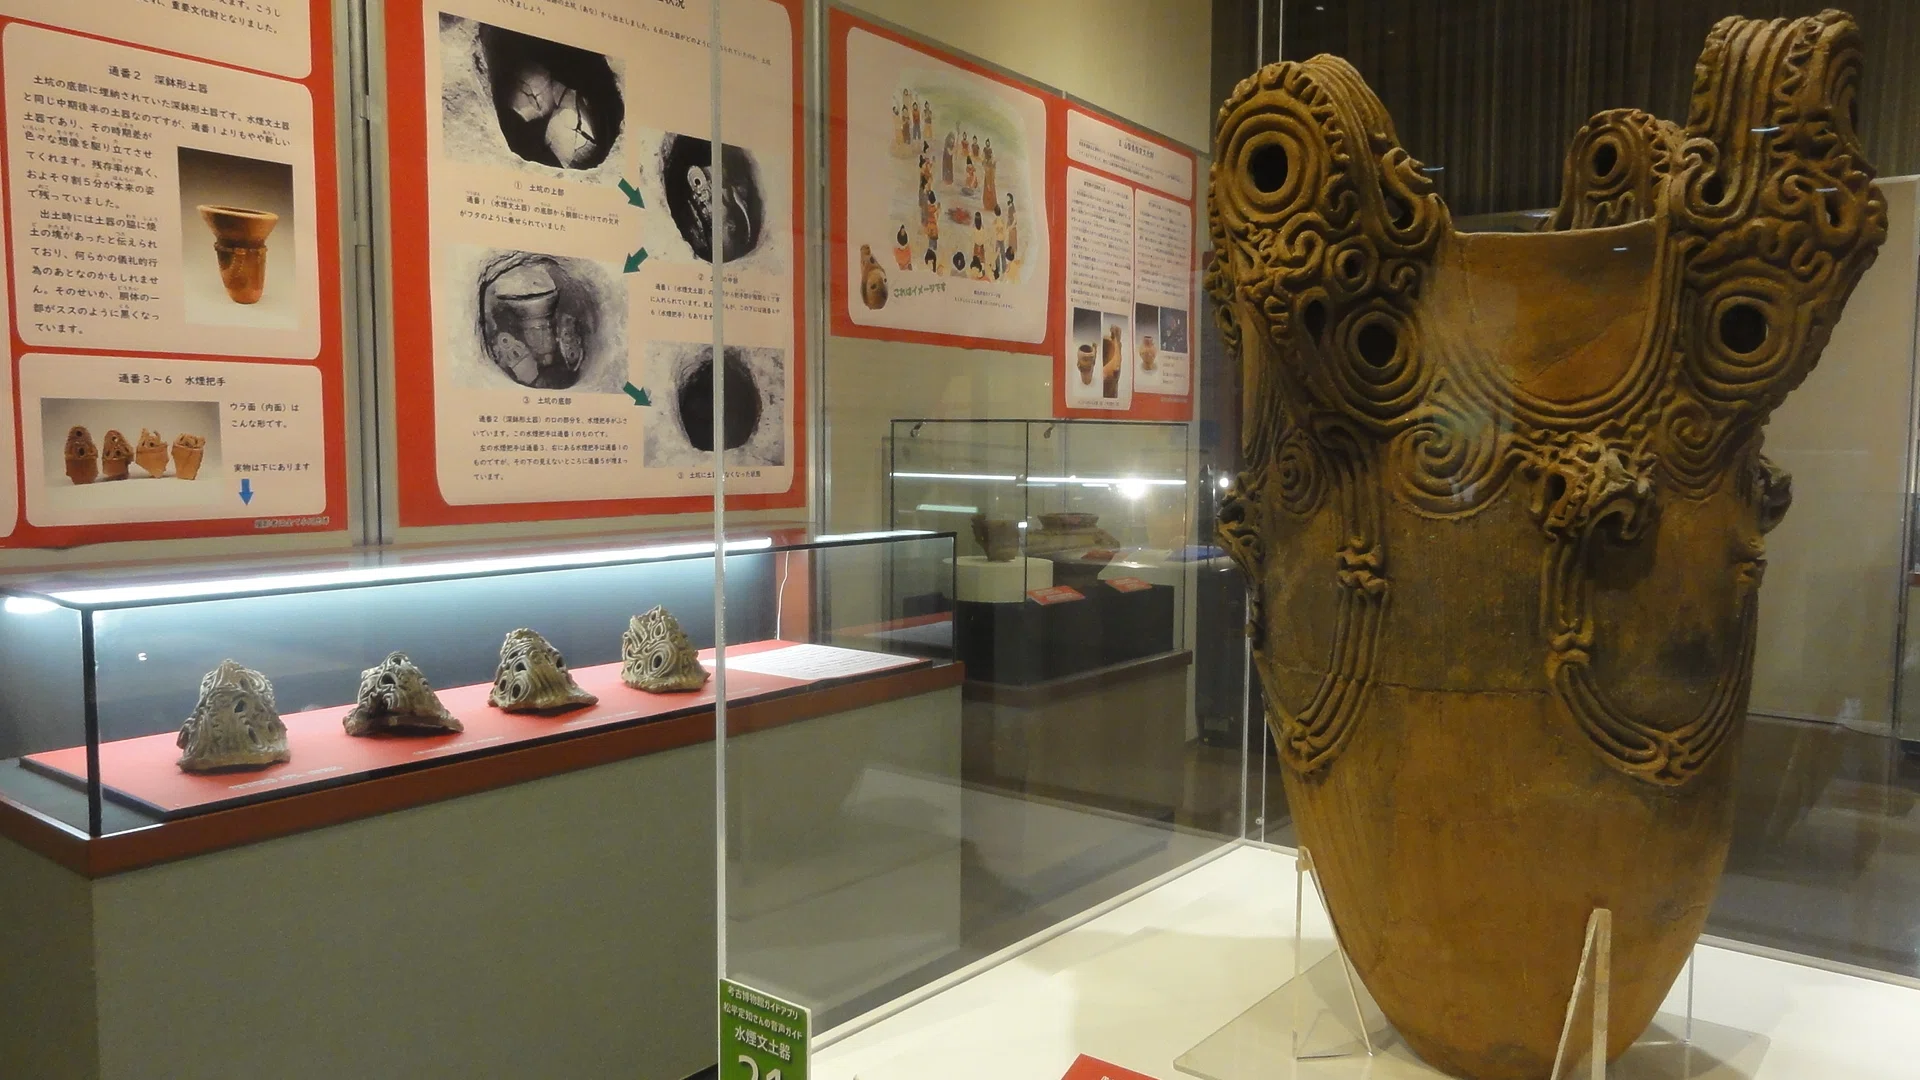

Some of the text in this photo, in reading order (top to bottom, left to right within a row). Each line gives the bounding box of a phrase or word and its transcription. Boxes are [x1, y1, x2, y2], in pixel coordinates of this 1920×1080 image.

[108, 65, 208, 94] 通番2 深鉢形土器
[35, 323, 84, 335] ています。
[185, 375, 226, 387] 水煙把手
[231, 420, 287, 428] こんな形です。
[234, 463, 310, 473] 実物は下にあります
[727, 985, 798, 1020] 考古博物館ガイドアプリ
[723, 1001, 803, 1041] 松平定知さんの音声ガイド
[734, 1025, 791, 1061] 水煙文土器
